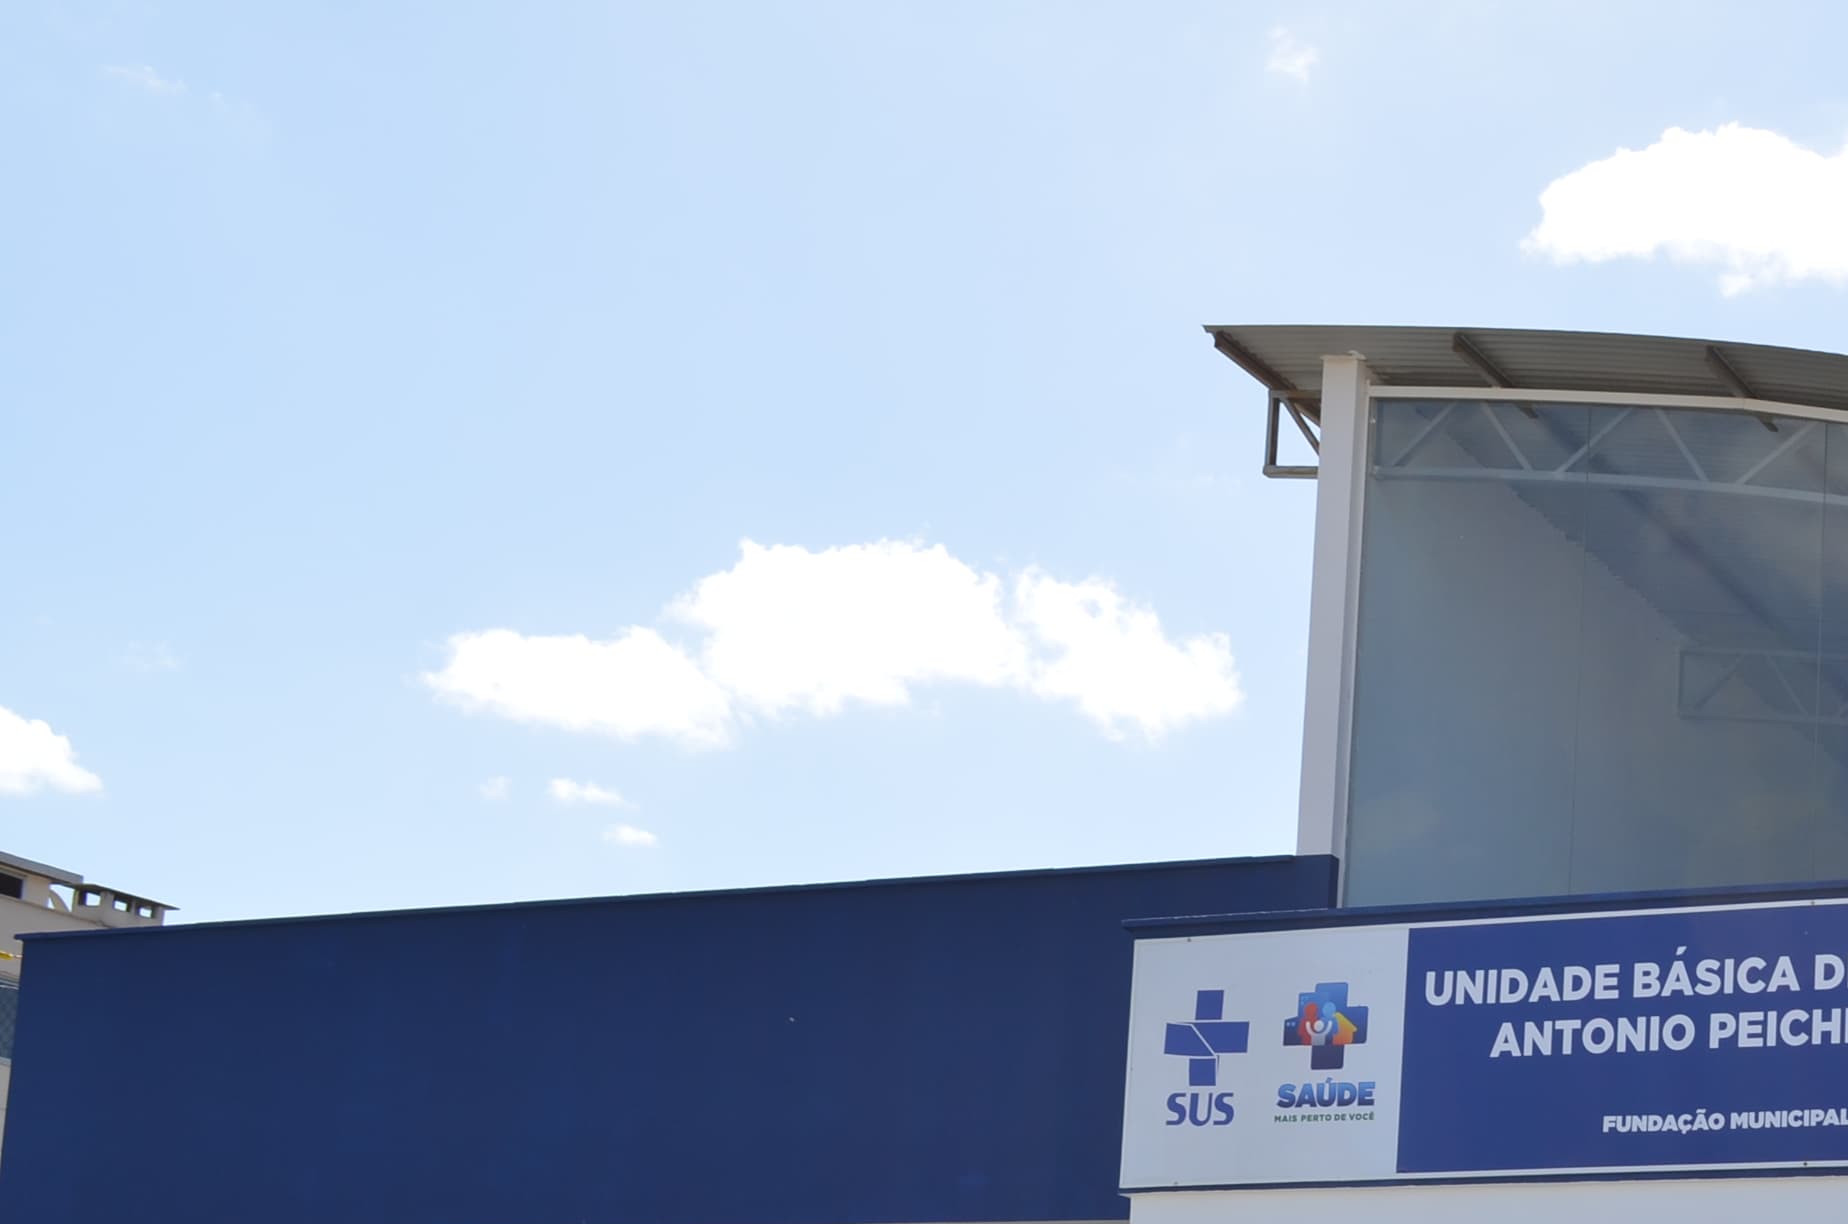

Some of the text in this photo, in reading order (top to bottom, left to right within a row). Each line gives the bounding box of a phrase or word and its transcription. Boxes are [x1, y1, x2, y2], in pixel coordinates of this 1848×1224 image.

[1424, 963, 1620, 1006] UNIDADE
[1633, 945, 1801, 998] BÁSICA
[1489, 1014, 1696, 1058] ANTONIO
[1165, 1092, 1236, 1127] SUS
[1276, 1077, 1376, 1109] SAÚDE
[1274, 1111, 1375, 1123] MAIS PERTO DE VOCÊ
[1602, 1109, 1726, 1135] FUNDAÇÃO
